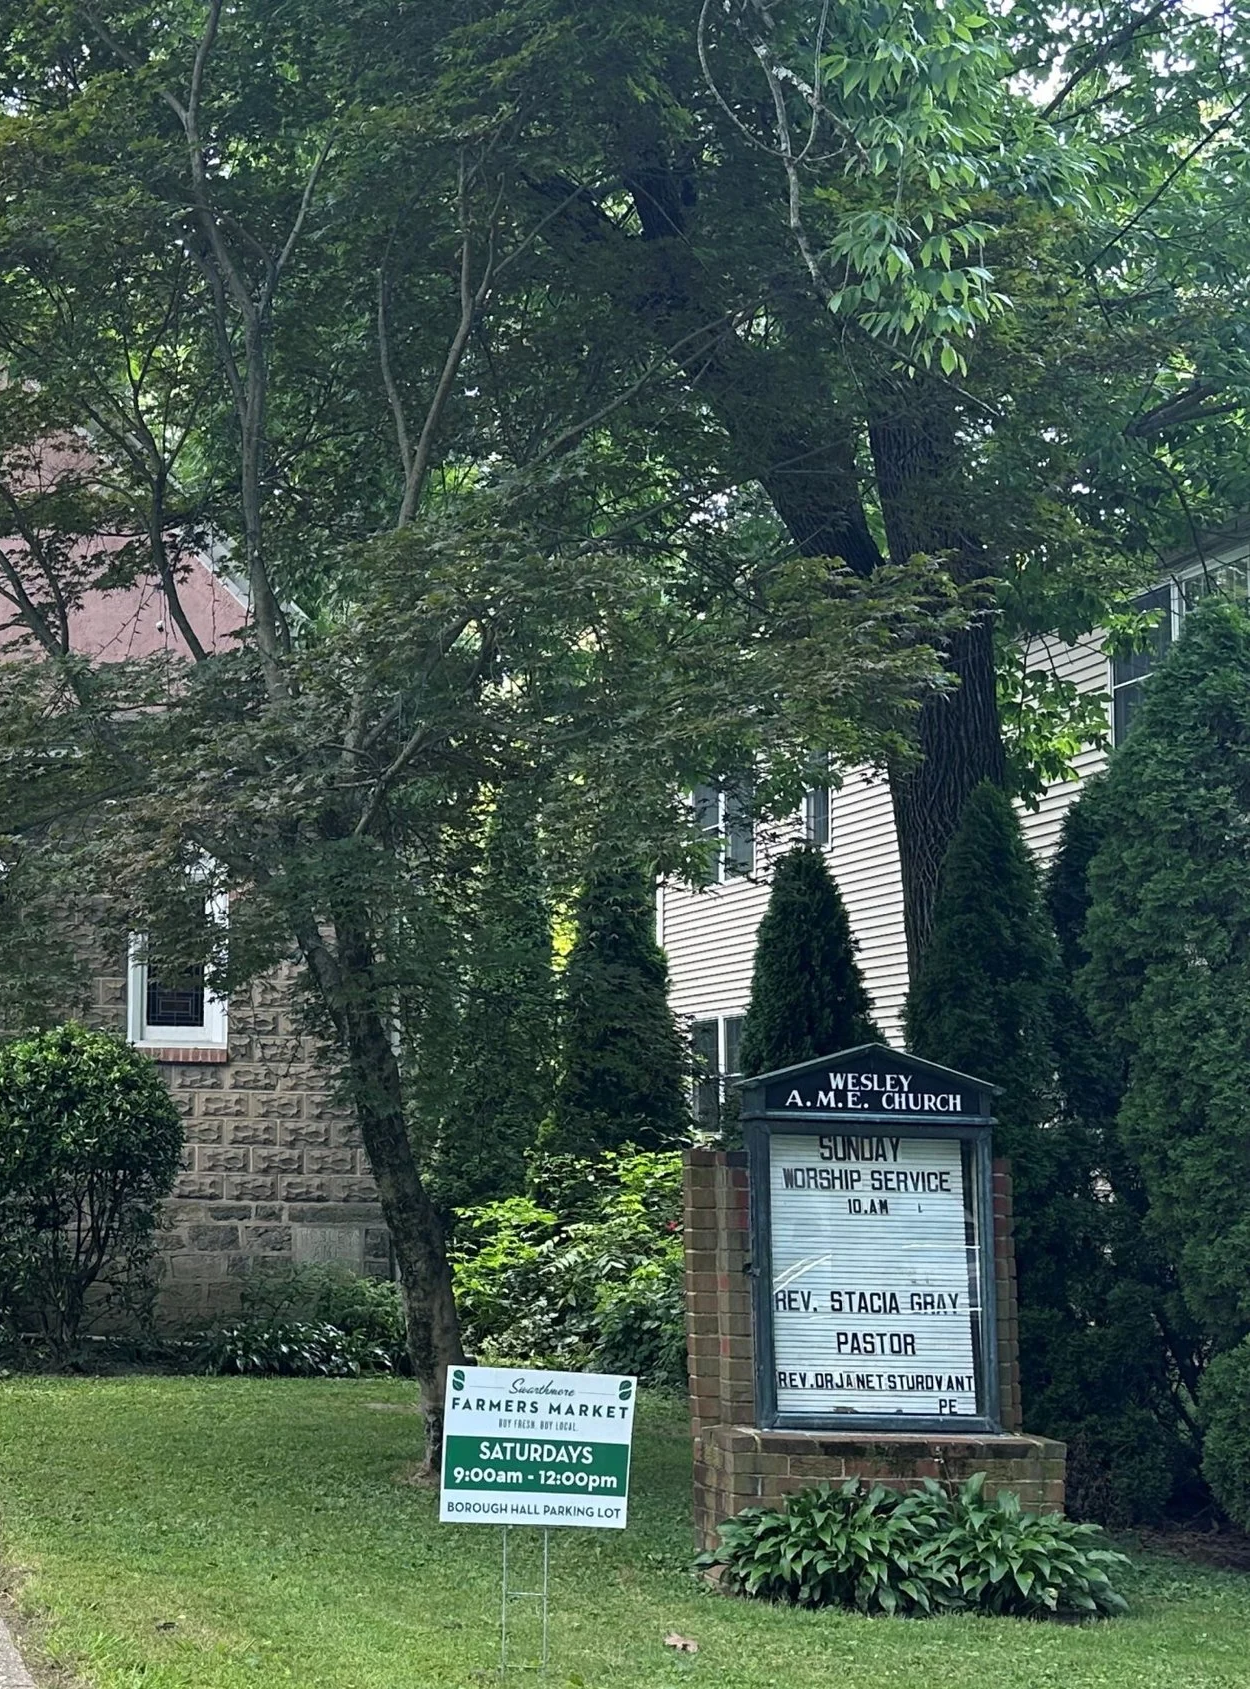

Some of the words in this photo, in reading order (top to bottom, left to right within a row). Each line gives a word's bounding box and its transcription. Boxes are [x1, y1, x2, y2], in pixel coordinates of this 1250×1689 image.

[828, 1072, 913, 1092] WESLEY
[785, 1089, 869, 1109] A.M.E.
[882, 1092, 962, 1112] CHURCH
[818, 1136, 900, 1162] SUNDAY
[782, 1167, 861, 1190] WORSHIP
[871, 1170, 951, 1192] SERVICE
[775, 1290, 818, 1312] REV.
[830, 1291, 900, 1313] STACIA
[910, 1293, 959, 1314] GRAY
[836, 1332, 916, 1355] PASTOR
[508, 1377, 575, 1397] Swarthmore
[451, 1397, 539, 1414] FARMERS
[548, 1403, 629, 1419] MARKET
[938, 1398, 958, 1414] PE
[498, 1418, 513, 1429] BUY
[539, 1420, 553, 1431] BUY
[479, 1441, 593, 1465] SATURDAYS
[453, 1467, 523, 1484] 9:00am
[538, 1470, 618, 1491] 12:00pm
[447, 1501, 508, 1515] BOROUGH
[510, 1504, 540, 1516] HALL
[543, 1504, 595, 1518] PARKING
[597, 1507, 622, 1519] LOT
